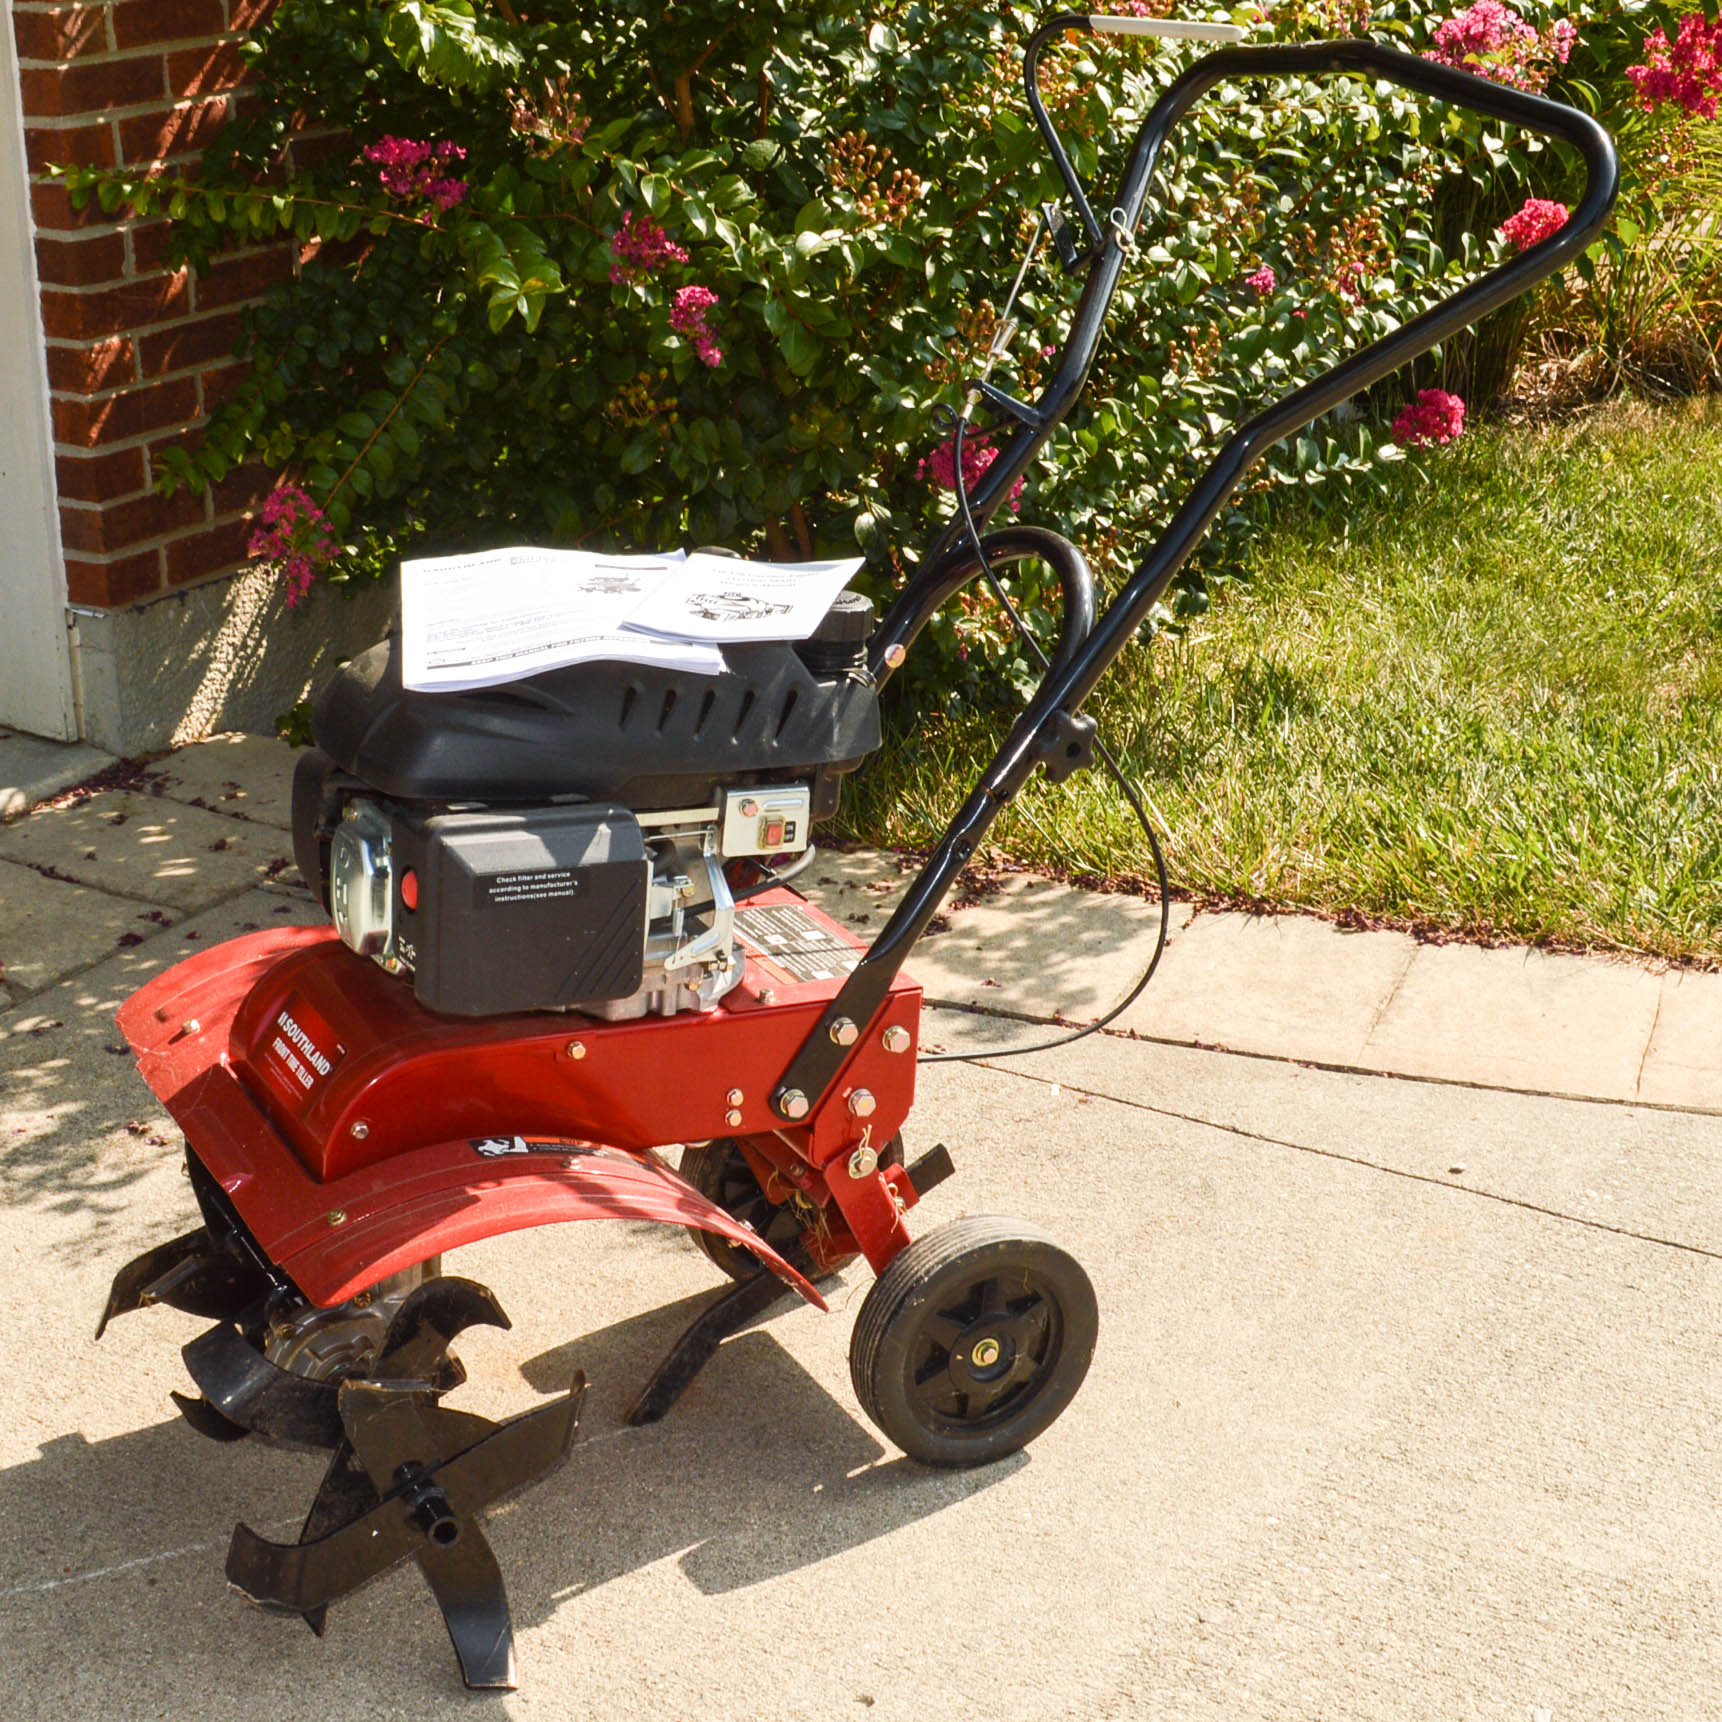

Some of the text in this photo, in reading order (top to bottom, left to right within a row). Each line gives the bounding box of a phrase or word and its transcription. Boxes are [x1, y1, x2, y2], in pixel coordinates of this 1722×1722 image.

[489, 885, 521, 894] according
[530, 880, 578, 890] manufacturer's
[496, 876, 516, 884] Check
[283, 1018, 331, 1076] SOUTHLAND
